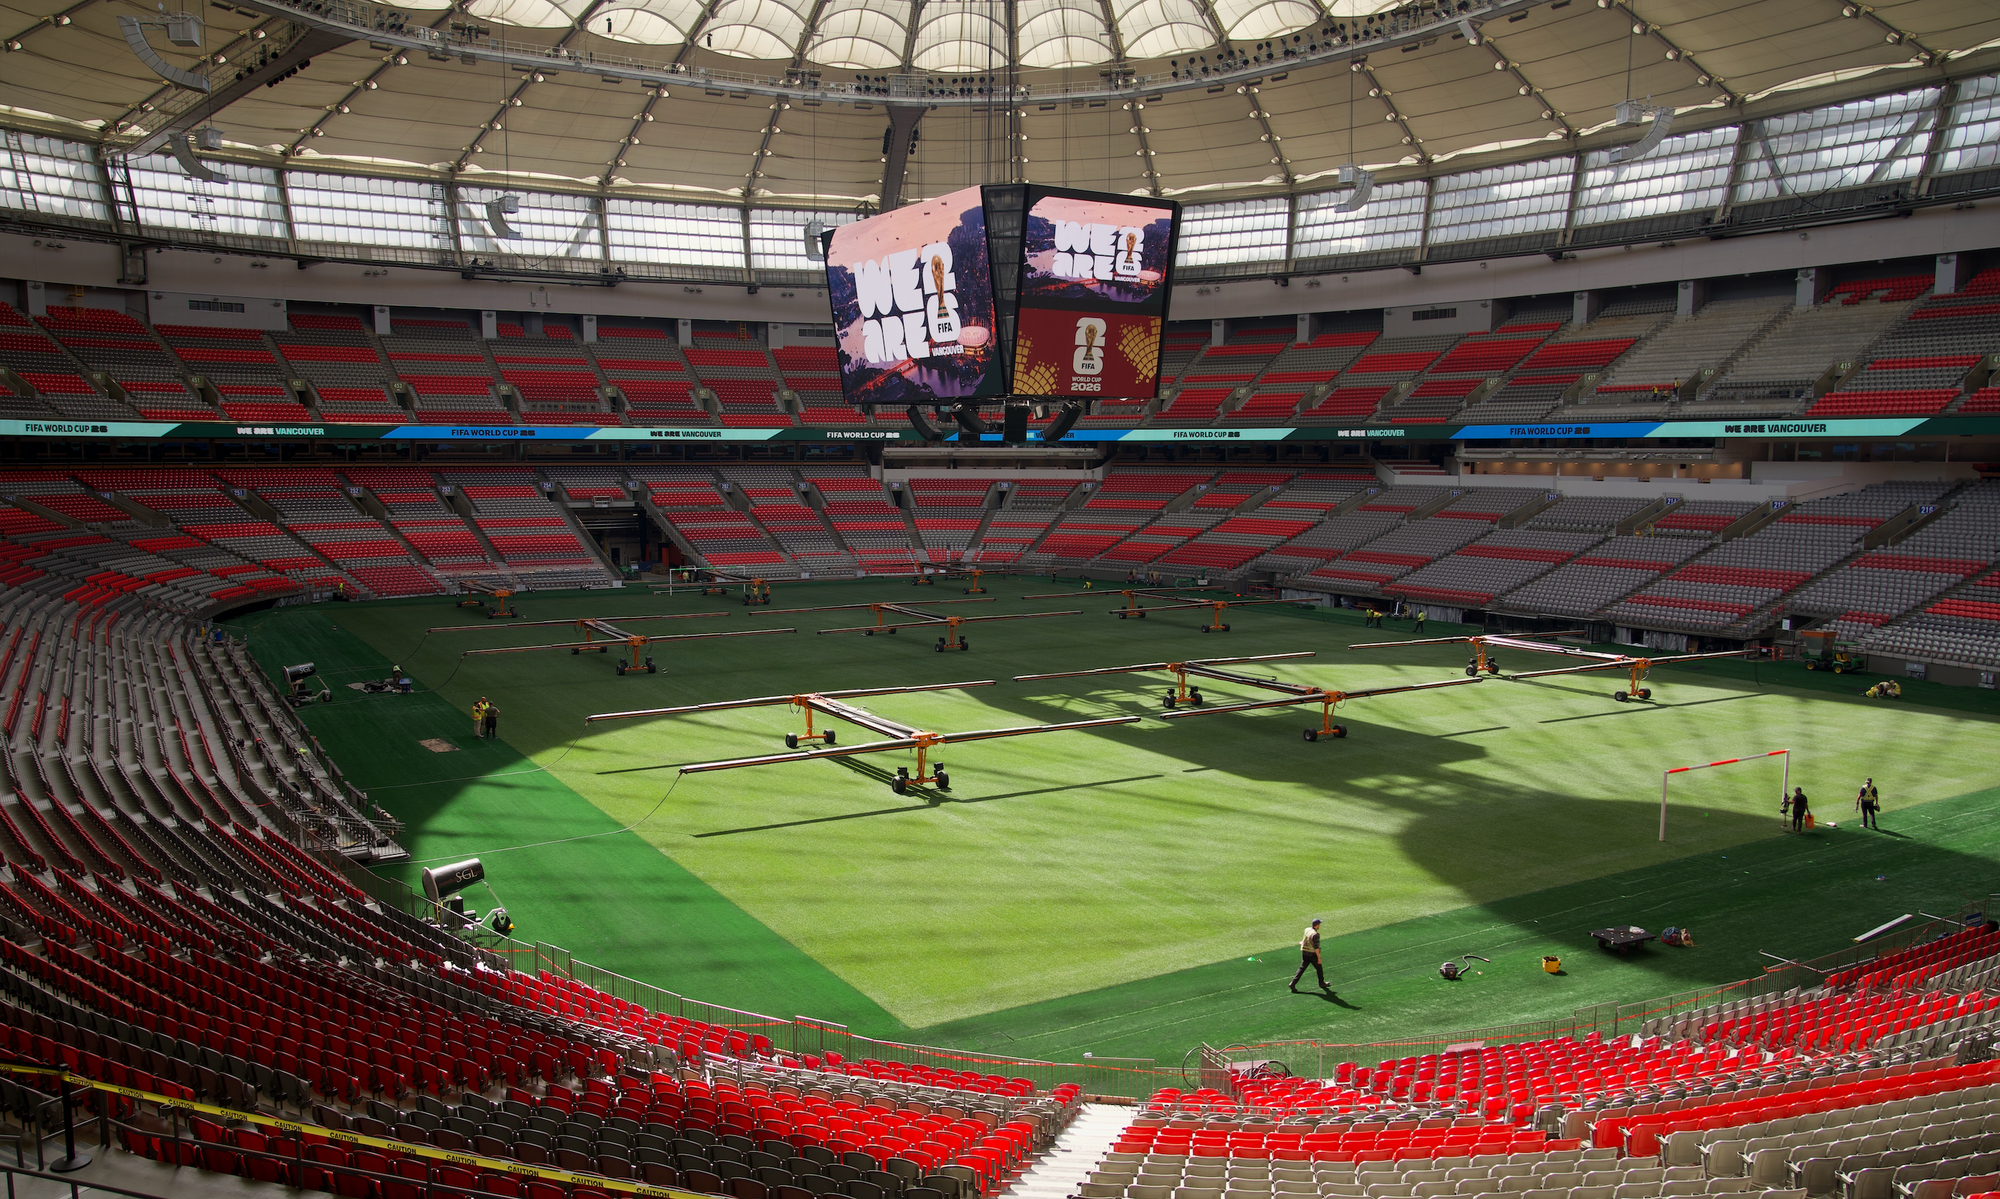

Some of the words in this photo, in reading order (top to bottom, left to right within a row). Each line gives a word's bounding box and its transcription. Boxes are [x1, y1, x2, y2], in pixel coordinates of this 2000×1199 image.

[1055, 220, 1118, 256] WE
[853, 248, 924, 318] WE
[937, 322, 953, 333] FIFA
[931, 345, 965, 357] VANCOUVER
[1070, 382, 1102, 392] 2026
[25, 424, 44, 432] FIFA
[74, 425, 90, 433] CUP
[90, 425, 108, 433] 26
[237, 427, 253, 435] WE
[1366, 429, 1405, 437] VANCOUVER
[1556, 427, 1573, 435] CUP
[1574, 427, 1591, 435] 26
[1725, 425, 1742, 433] WE
[1767, 424, 1827, 433] VANCOUVER
[456, 867, 477, 883] SGL
[69, 1078, 94, 1087] CAUTION
[118, 1088, 144, 1099] CAUTION
[168, 1099, 195, 1110] CAUTION
[220, 1110, 248, 1121] CAUTION
[274, 1121, 302, 1132] CAUTION
[330, 1132, 359, 1143] CAUTION
[387, 1144, 417, 1155] CAUTION
[446, 1155, 477, 1166] CAUTION
[507, 1165, 539, 1177] CAUTION
[571, 1176, 604, 1187] CAUTION
[636, 1187, 670, 1198] CAUTION
